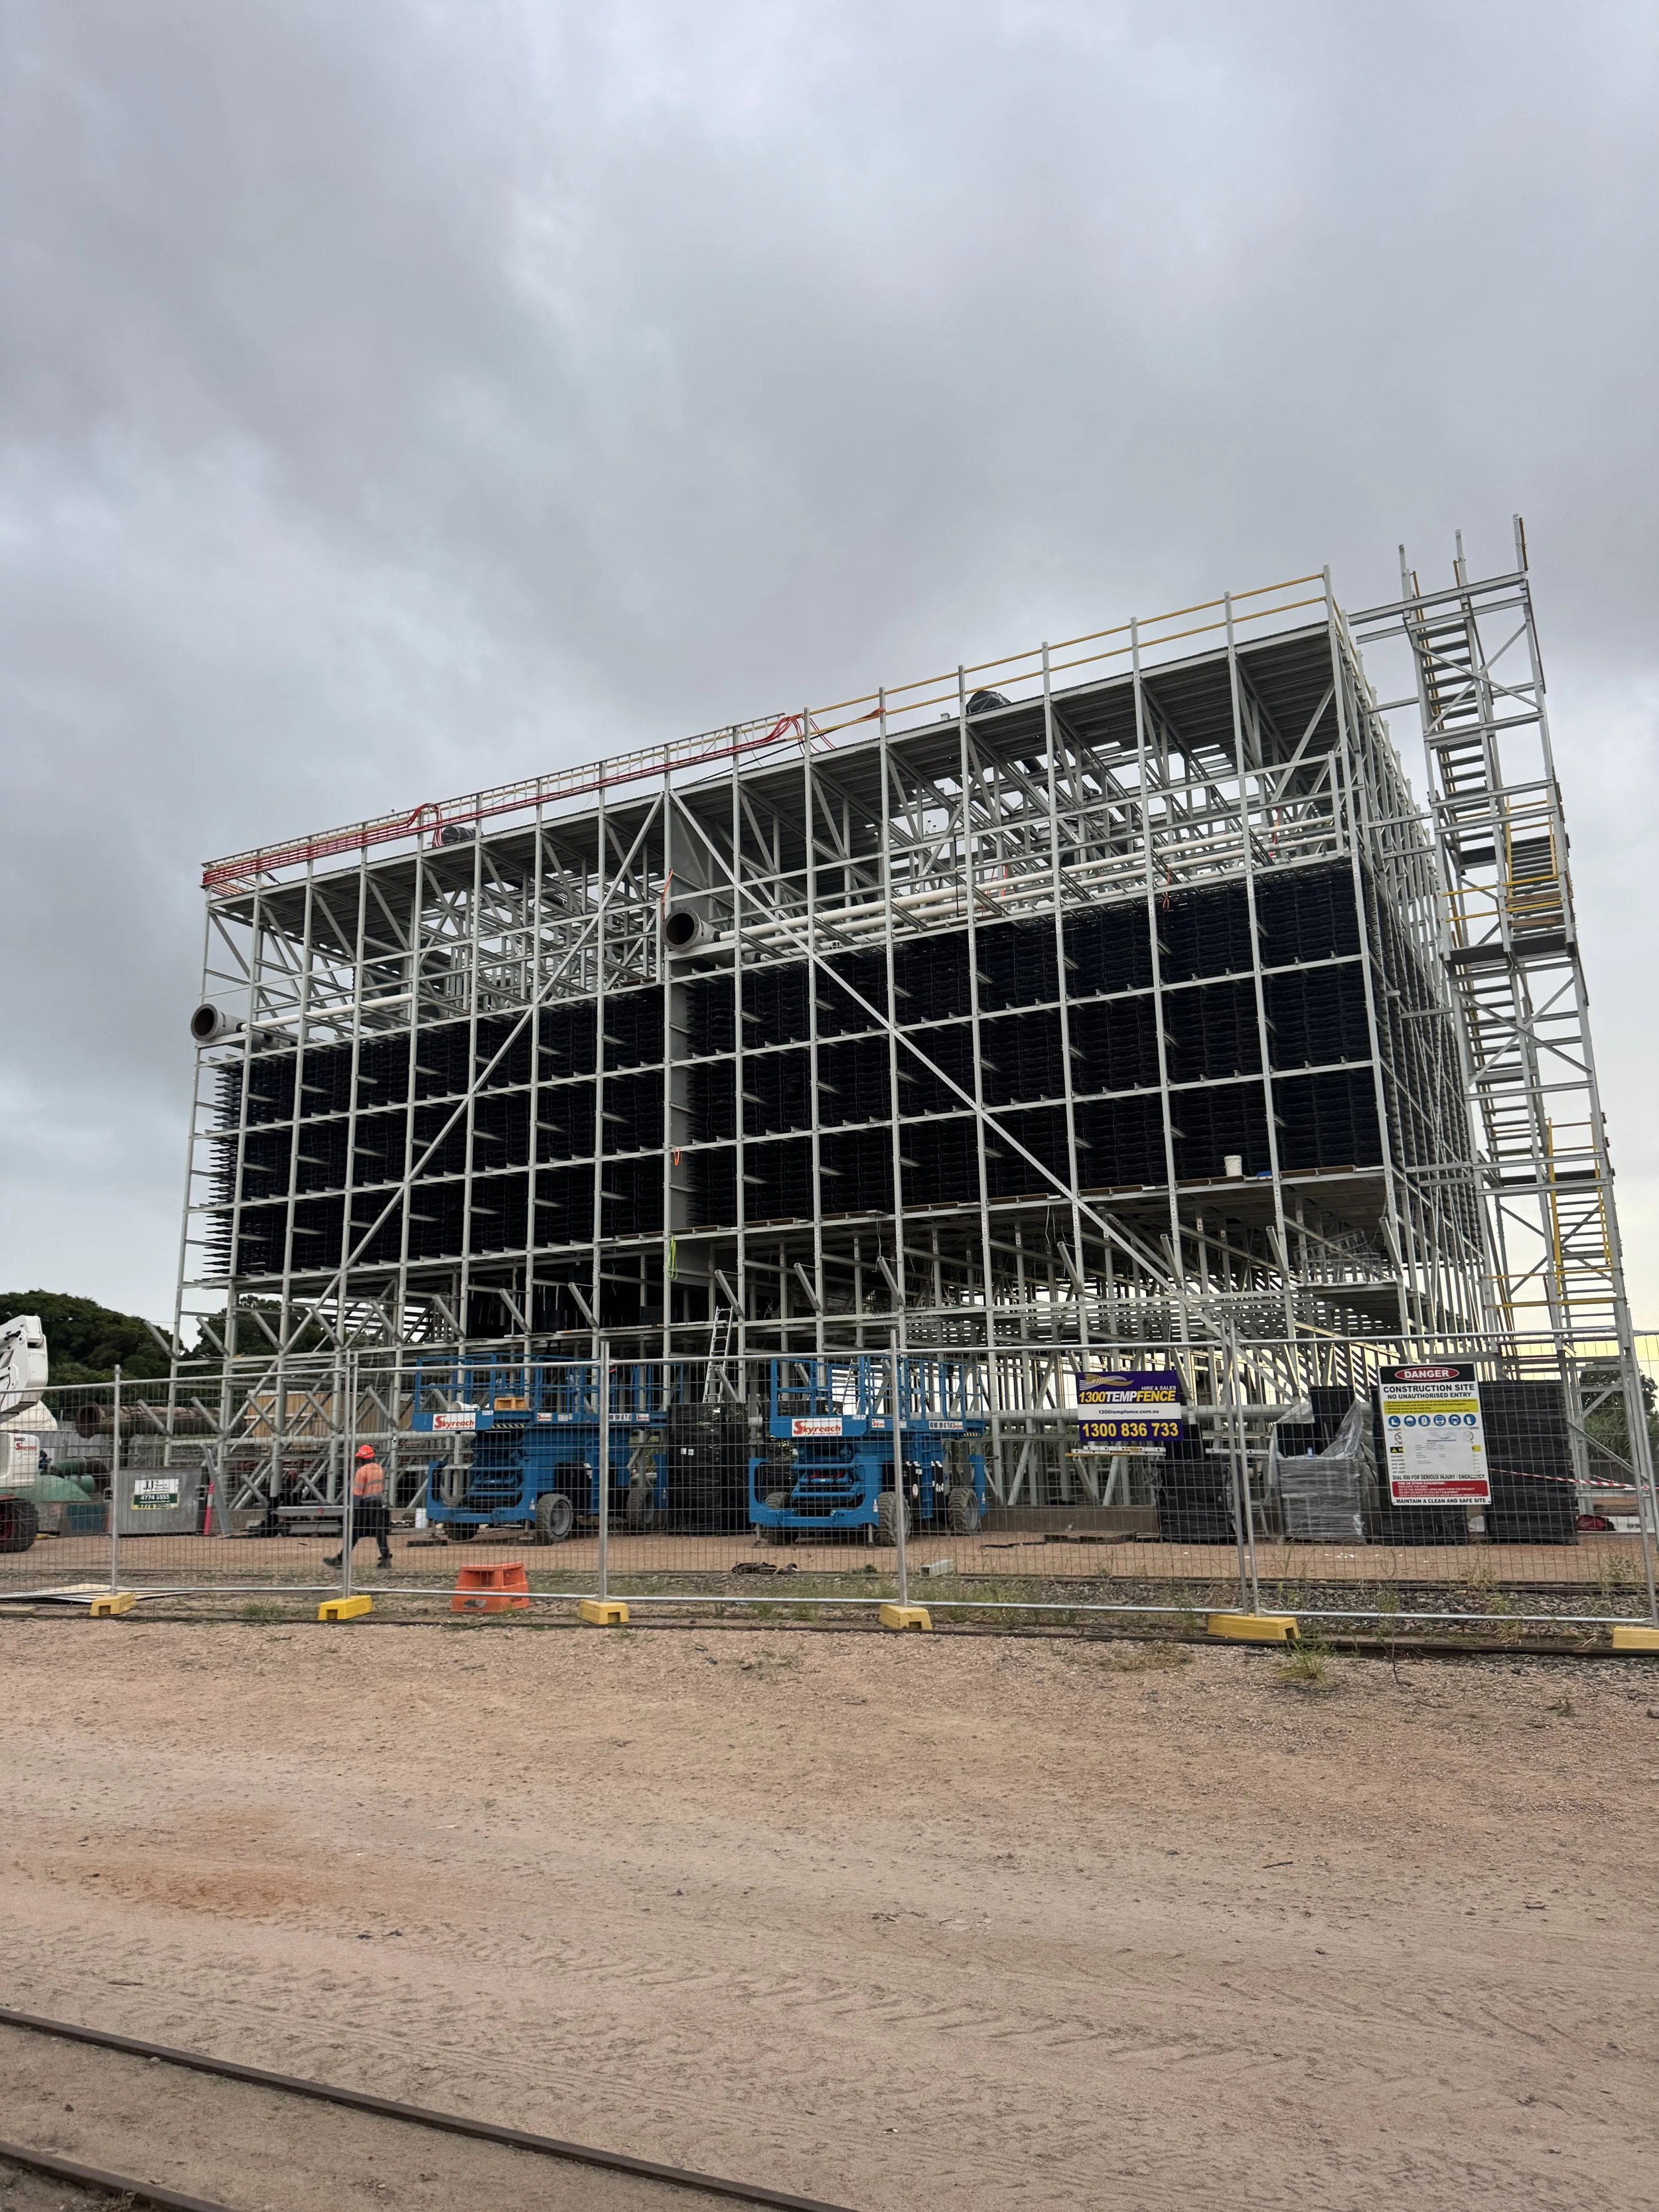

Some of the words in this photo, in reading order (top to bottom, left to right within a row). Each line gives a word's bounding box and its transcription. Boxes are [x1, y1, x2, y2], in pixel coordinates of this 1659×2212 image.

[1404, 1370, 1449, 1378] DANGER
[1384, 1384, 1452, 1393] CONSTRUCTION
[1079, 1390, 1176, 1403] 1300TEMPFENCE
[434, 1414, 474, 1429] Skyreach
[794, 1420, 841, 1434] Skyreach
[1082, 1422, 1117, 1438] 1300
[1121, 1422, 1147, 1437] 836
[1151, 1422, 1179, 1437] 733
